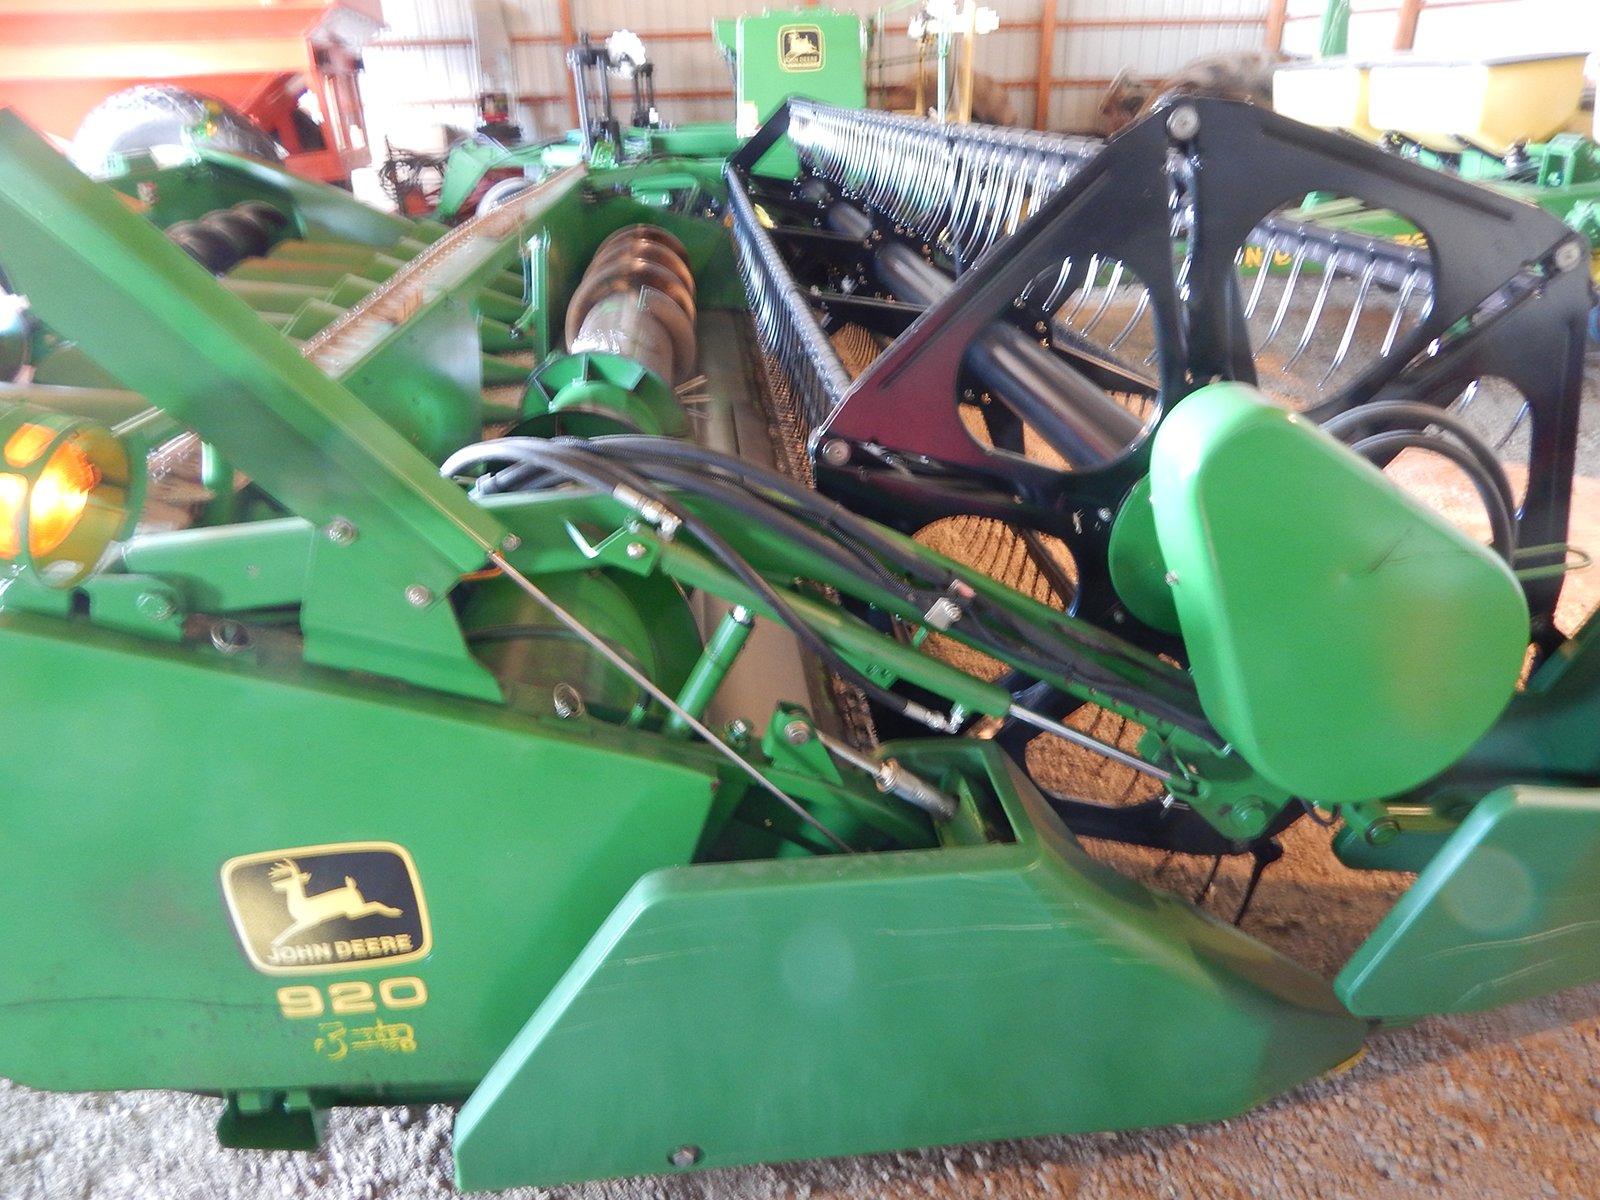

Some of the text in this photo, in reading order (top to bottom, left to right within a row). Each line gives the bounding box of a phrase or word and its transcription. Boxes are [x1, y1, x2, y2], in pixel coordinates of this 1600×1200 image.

[268, 934, 413, 964] JOHN DEERE
[277, 976, 428, 1020] 920
